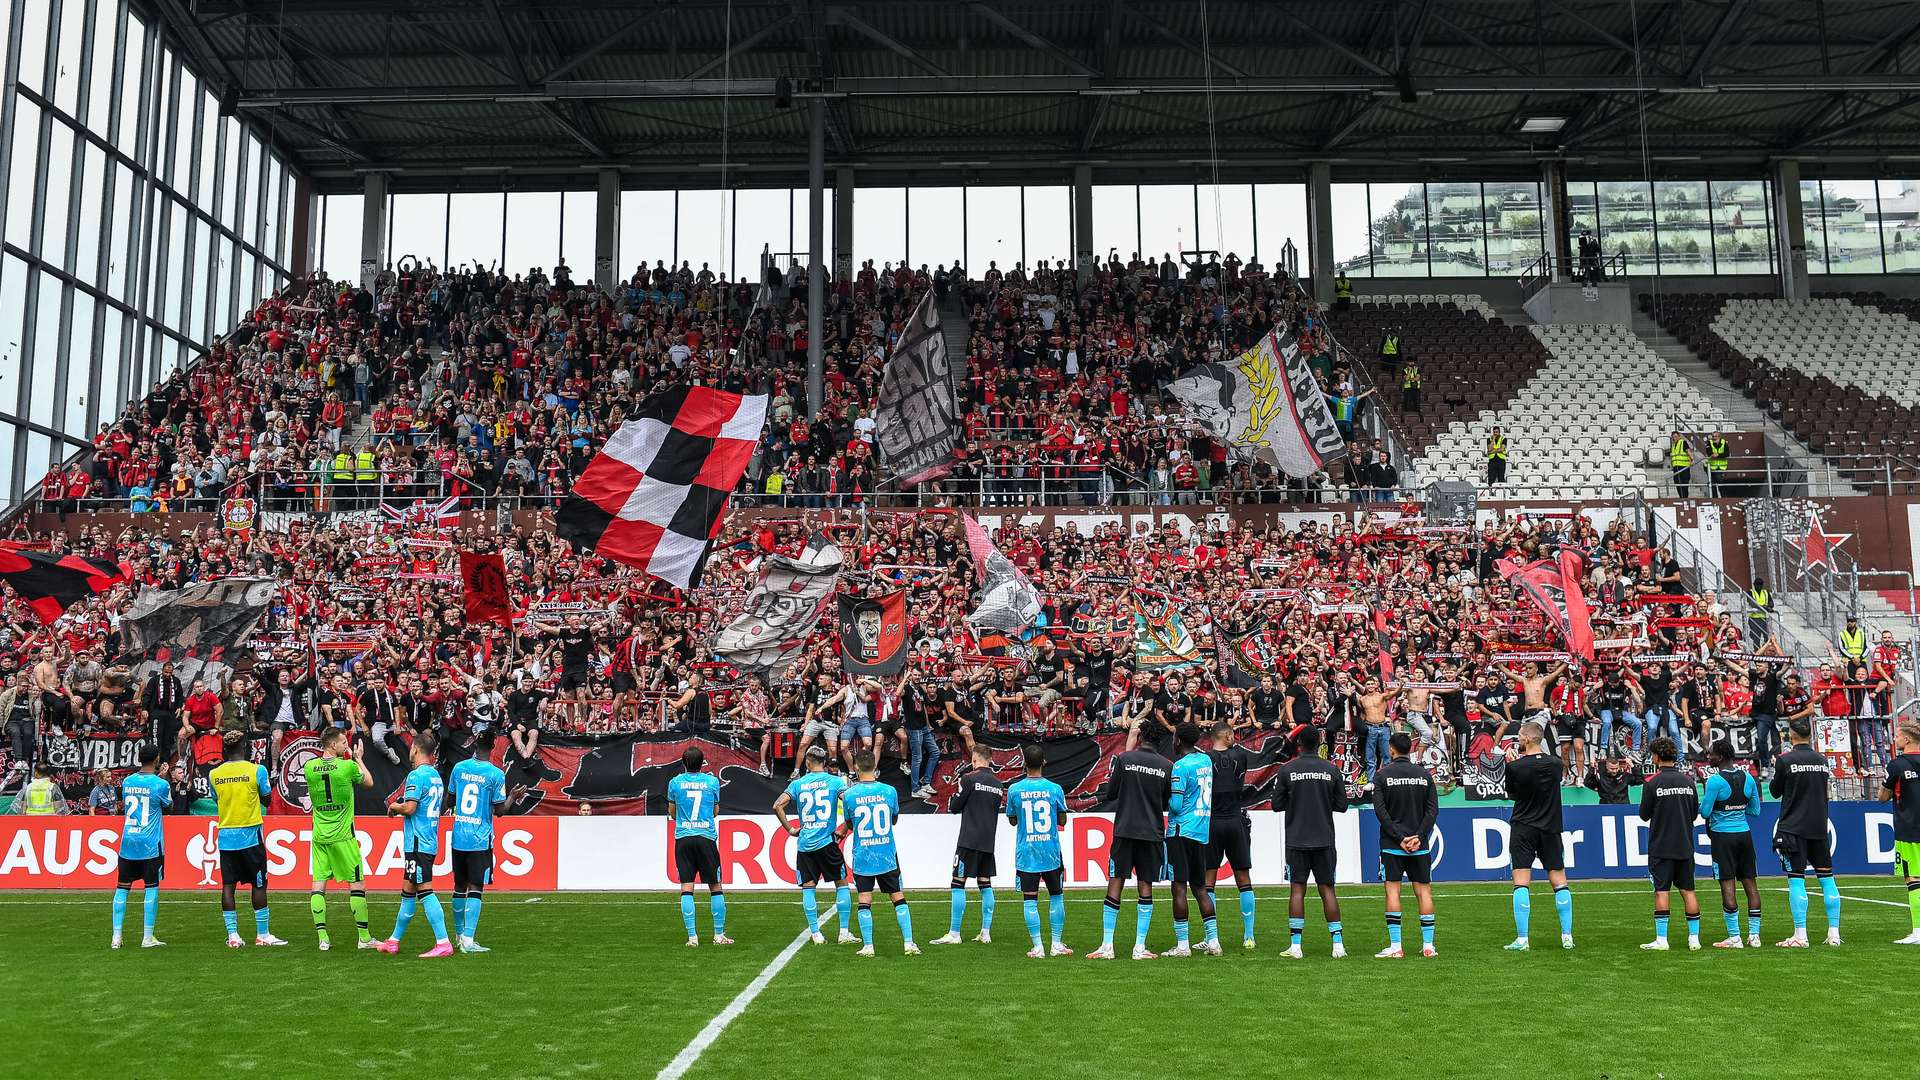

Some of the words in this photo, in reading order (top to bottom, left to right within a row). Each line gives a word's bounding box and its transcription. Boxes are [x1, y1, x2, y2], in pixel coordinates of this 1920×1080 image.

[313, 764, 329, 773] BAYER
[214, 775, 251, 787] Barmenia
[461, 772, 479, 782] BAYER
[1289, 771, 1332, 783] Barmenia
[1386, 776, 1428, 787] Barmenia
[321, 774, 333, 803] 1
[1656, 785, 1694, 798] Barmenia
[460, 783, 479, 815] 6
[856, 796, 876, 805] BAYER
[876, 794, 886, 802] 04
[1020, 791, 1042, 801] BAYER
[1042, 790, 1051, 798] 04
[124, 795, 150, 827] 21
[686, 790, 703, 821] 7
[799, 788, 832, 822] 25
[854, 803, 891, 838] 20
[1020, 800, 1052, 834] 13
[1026, 832, 1051, 843] ARTHUR
